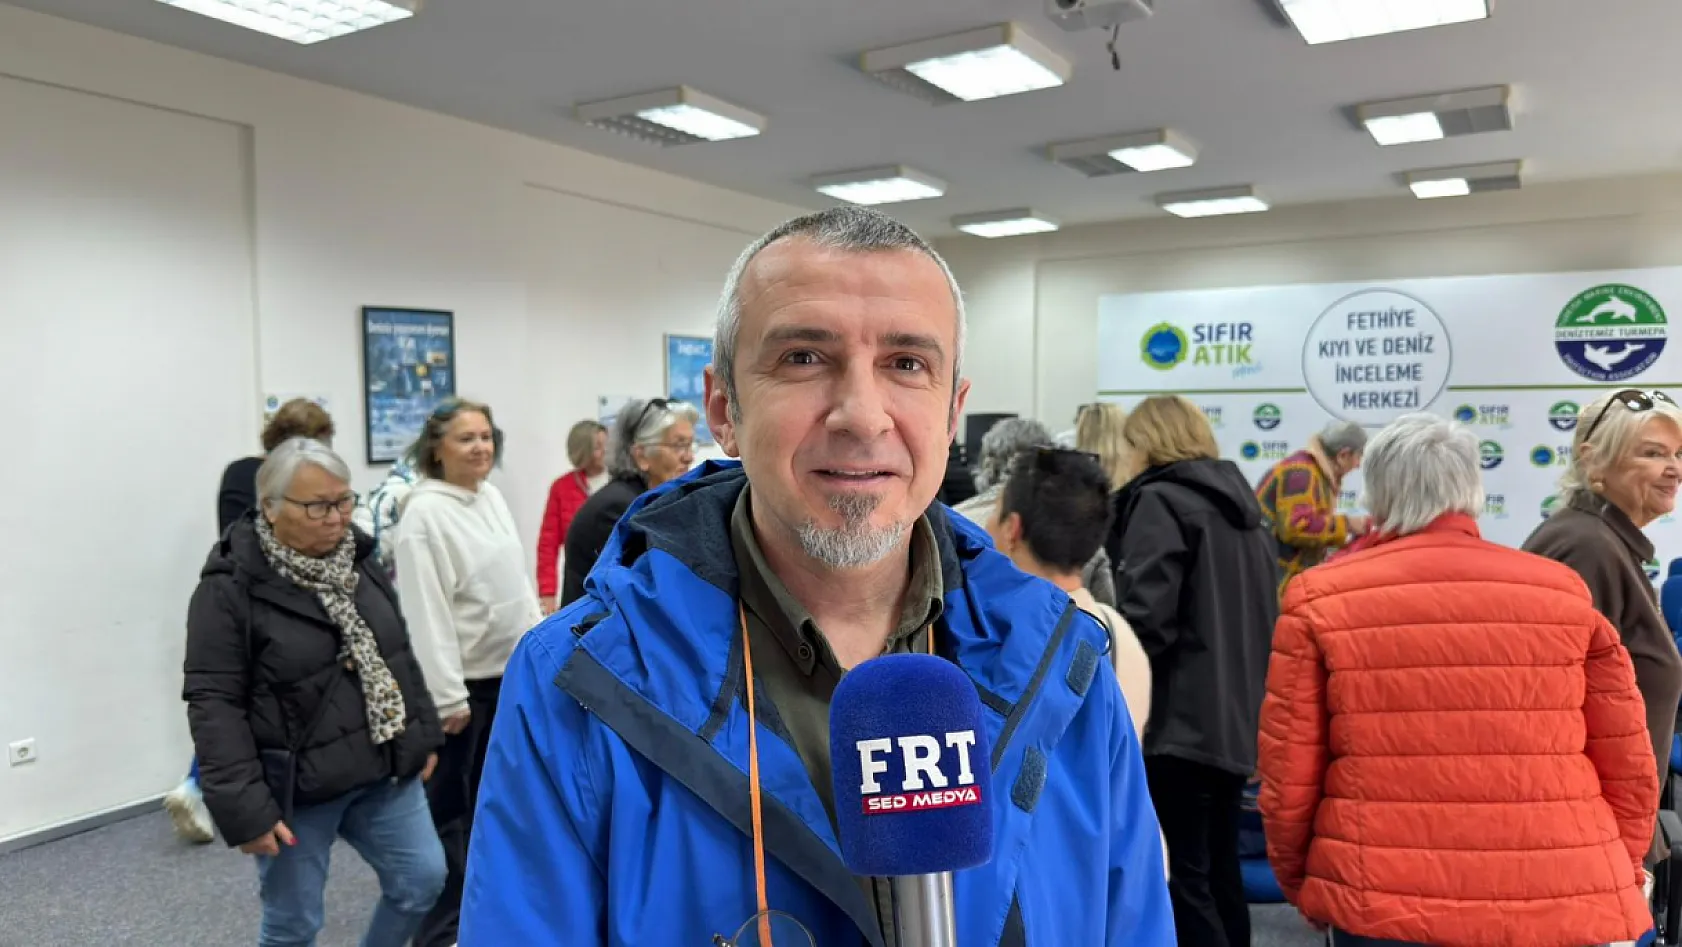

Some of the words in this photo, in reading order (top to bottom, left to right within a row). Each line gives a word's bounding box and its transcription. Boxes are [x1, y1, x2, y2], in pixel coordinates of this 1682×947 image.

[1347, 307, 1416, 330] FETHİYE
[1192, 322, 1253, 344] SIFIR
[1192, 343, 1253, 366] ATIK
[1318, 339, 1350, 358] KIYI
[1355, 337, 1377, 356] VE
[1382, 332, 1434, 355] DENİZ
[1335, 362, 1424, 384] İNCELEME
[1342, 387, 1420, 410] MERKEZİ
[856, 730, 976, 795] FRT
[868, 797, 907, 810] SED
[912, 788, 977, 807] MEDYA
